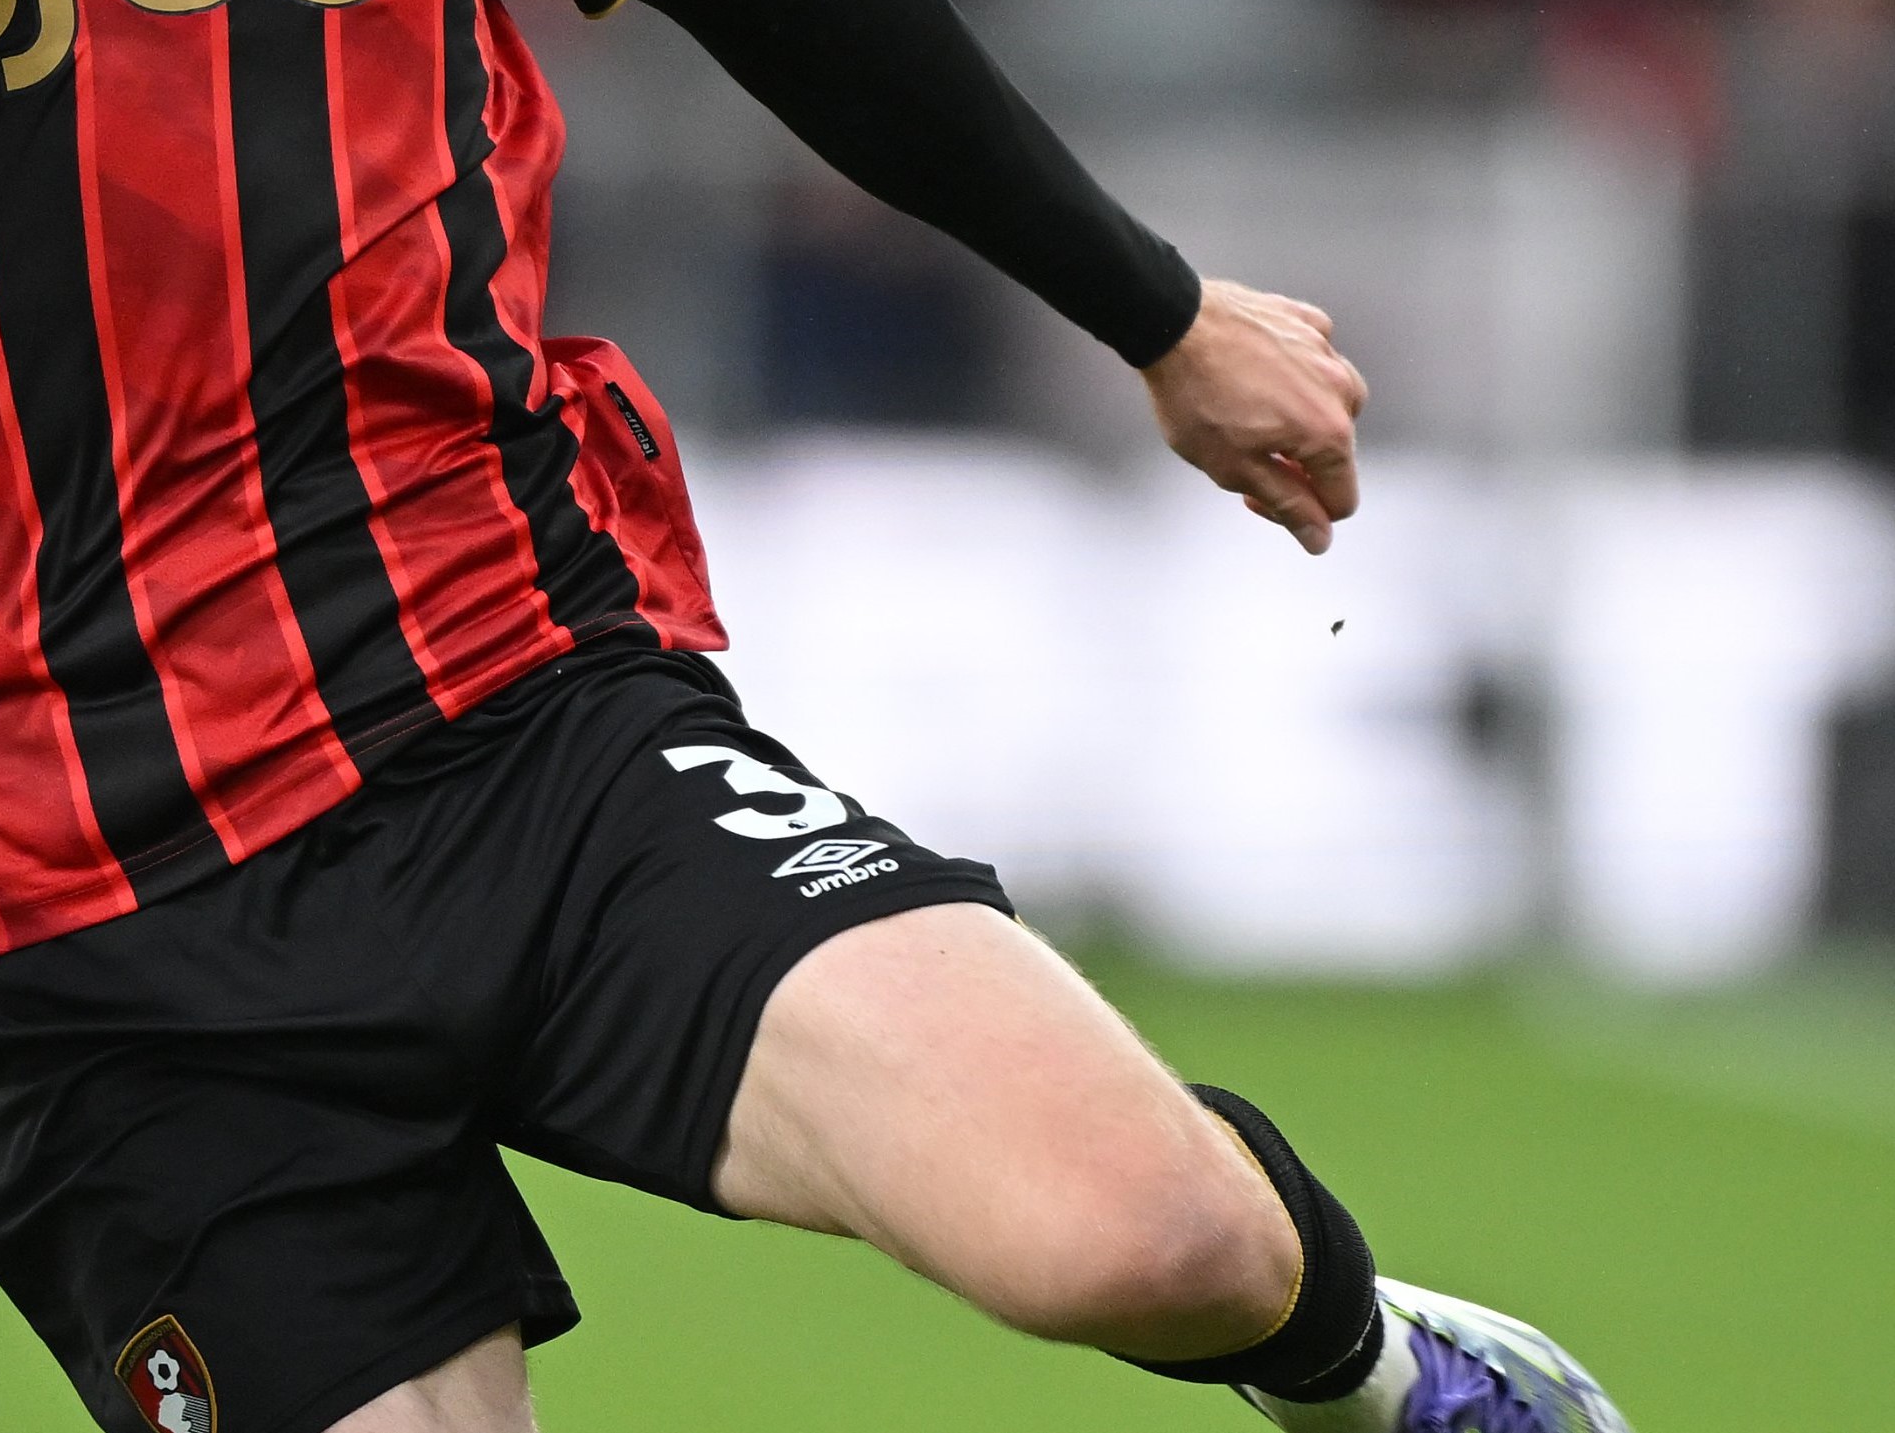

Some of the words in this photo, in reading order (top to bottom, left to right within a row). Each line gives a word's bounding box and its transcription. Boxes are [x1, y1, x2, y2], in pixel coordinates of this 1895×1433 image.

[625, 411, 655, 455] official
[661, 745, 848, 839] 3
[799, 857, 900, 898] umbro
